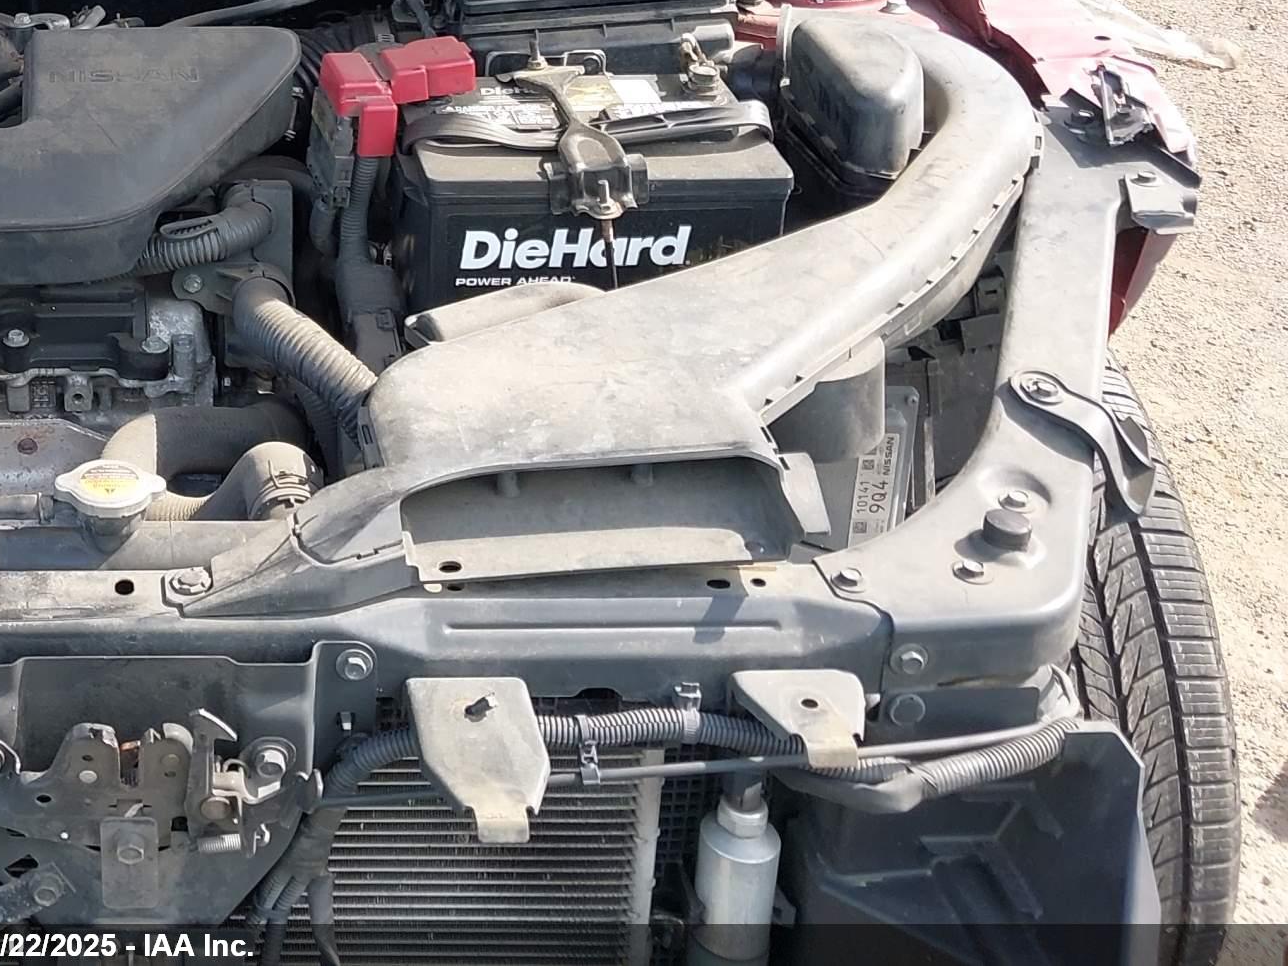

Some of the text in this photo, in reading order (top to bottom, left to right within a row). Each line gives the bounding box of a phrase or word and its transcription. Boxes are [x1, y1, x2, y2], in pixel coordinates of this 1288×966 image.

[460, 226, 692, 270] DieHard
[455, 276, 572, 287] POWER AHEAD
[882, 436, 895, 476] NISSAN
[856, 480, 870, 514] 10141
[868, 479, 889, 514] 9Q4
